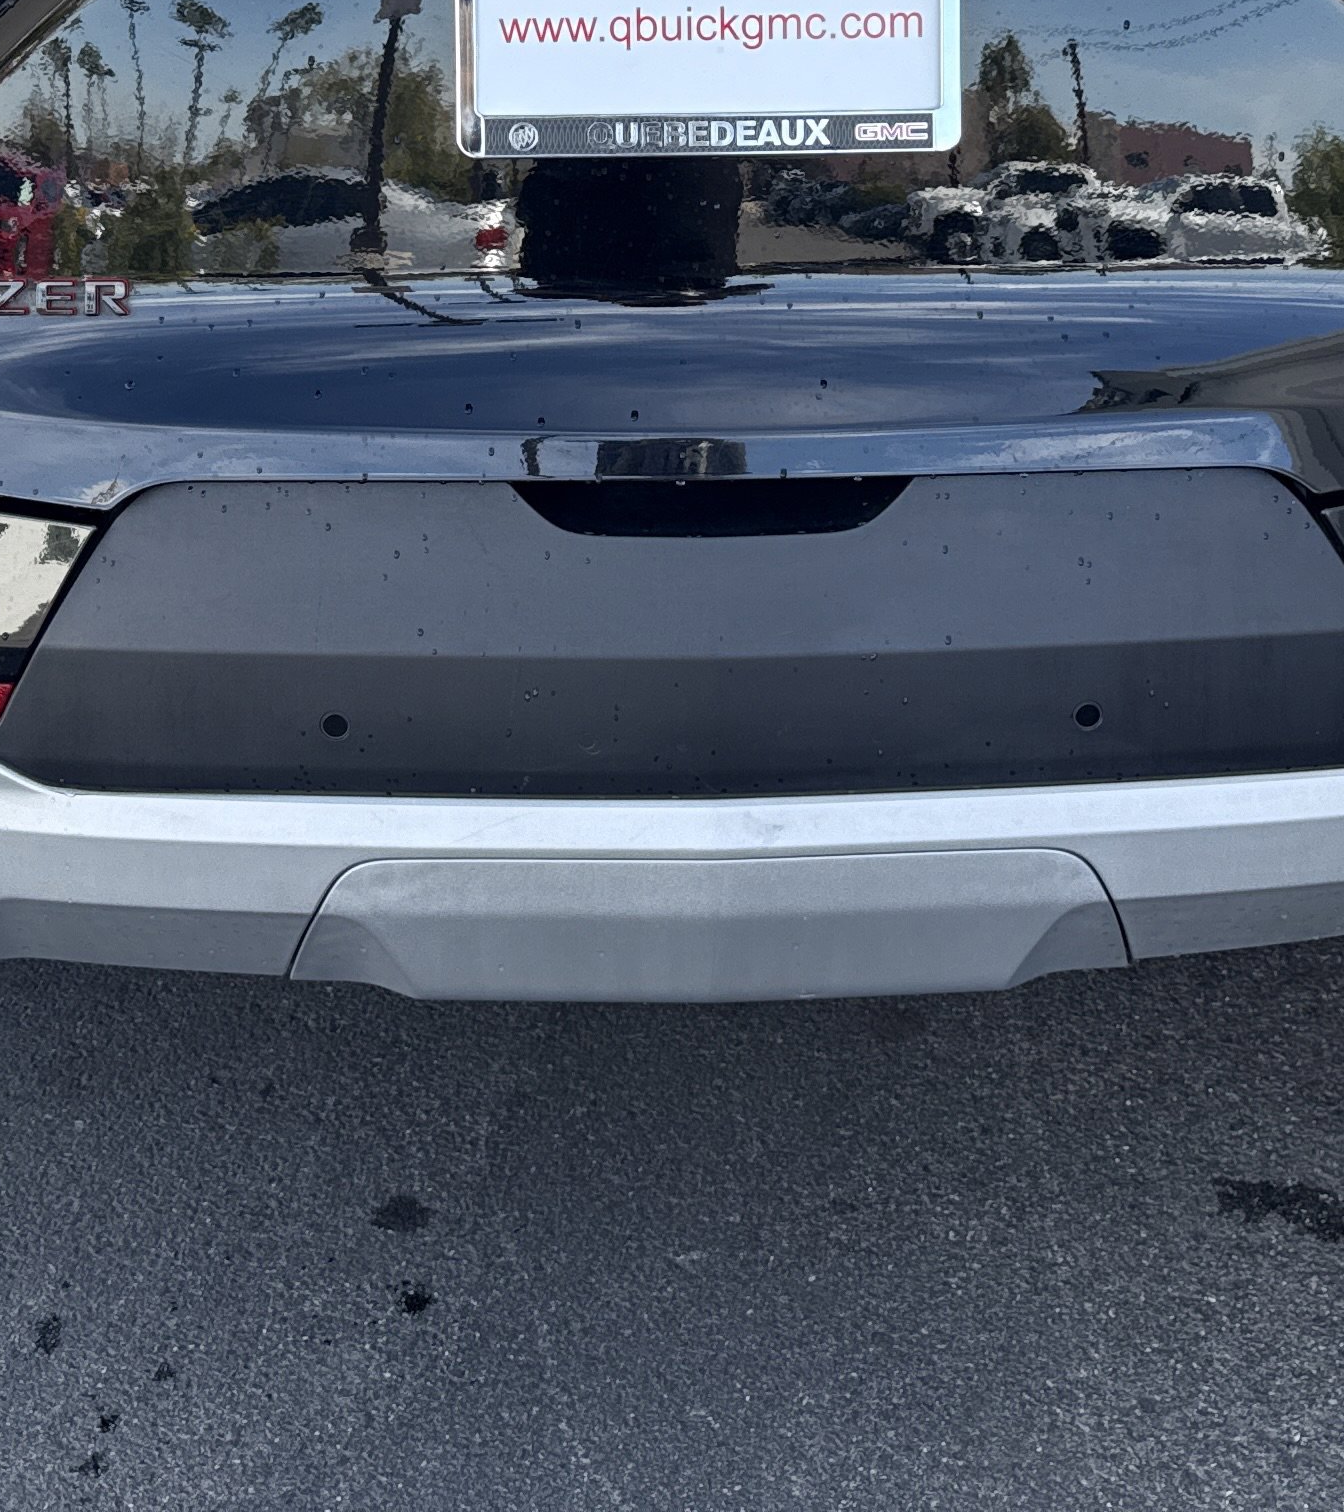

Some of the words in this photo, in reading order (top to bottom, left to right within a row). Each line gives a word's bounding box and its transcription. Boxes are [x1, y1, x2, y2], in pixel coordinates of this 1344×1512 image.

[498, 6, 924, 51] www.qbuickgmc.com
[586, 118, 832, 150] QUEBEDEAUX
[855, 121, 929, 141] GMC
